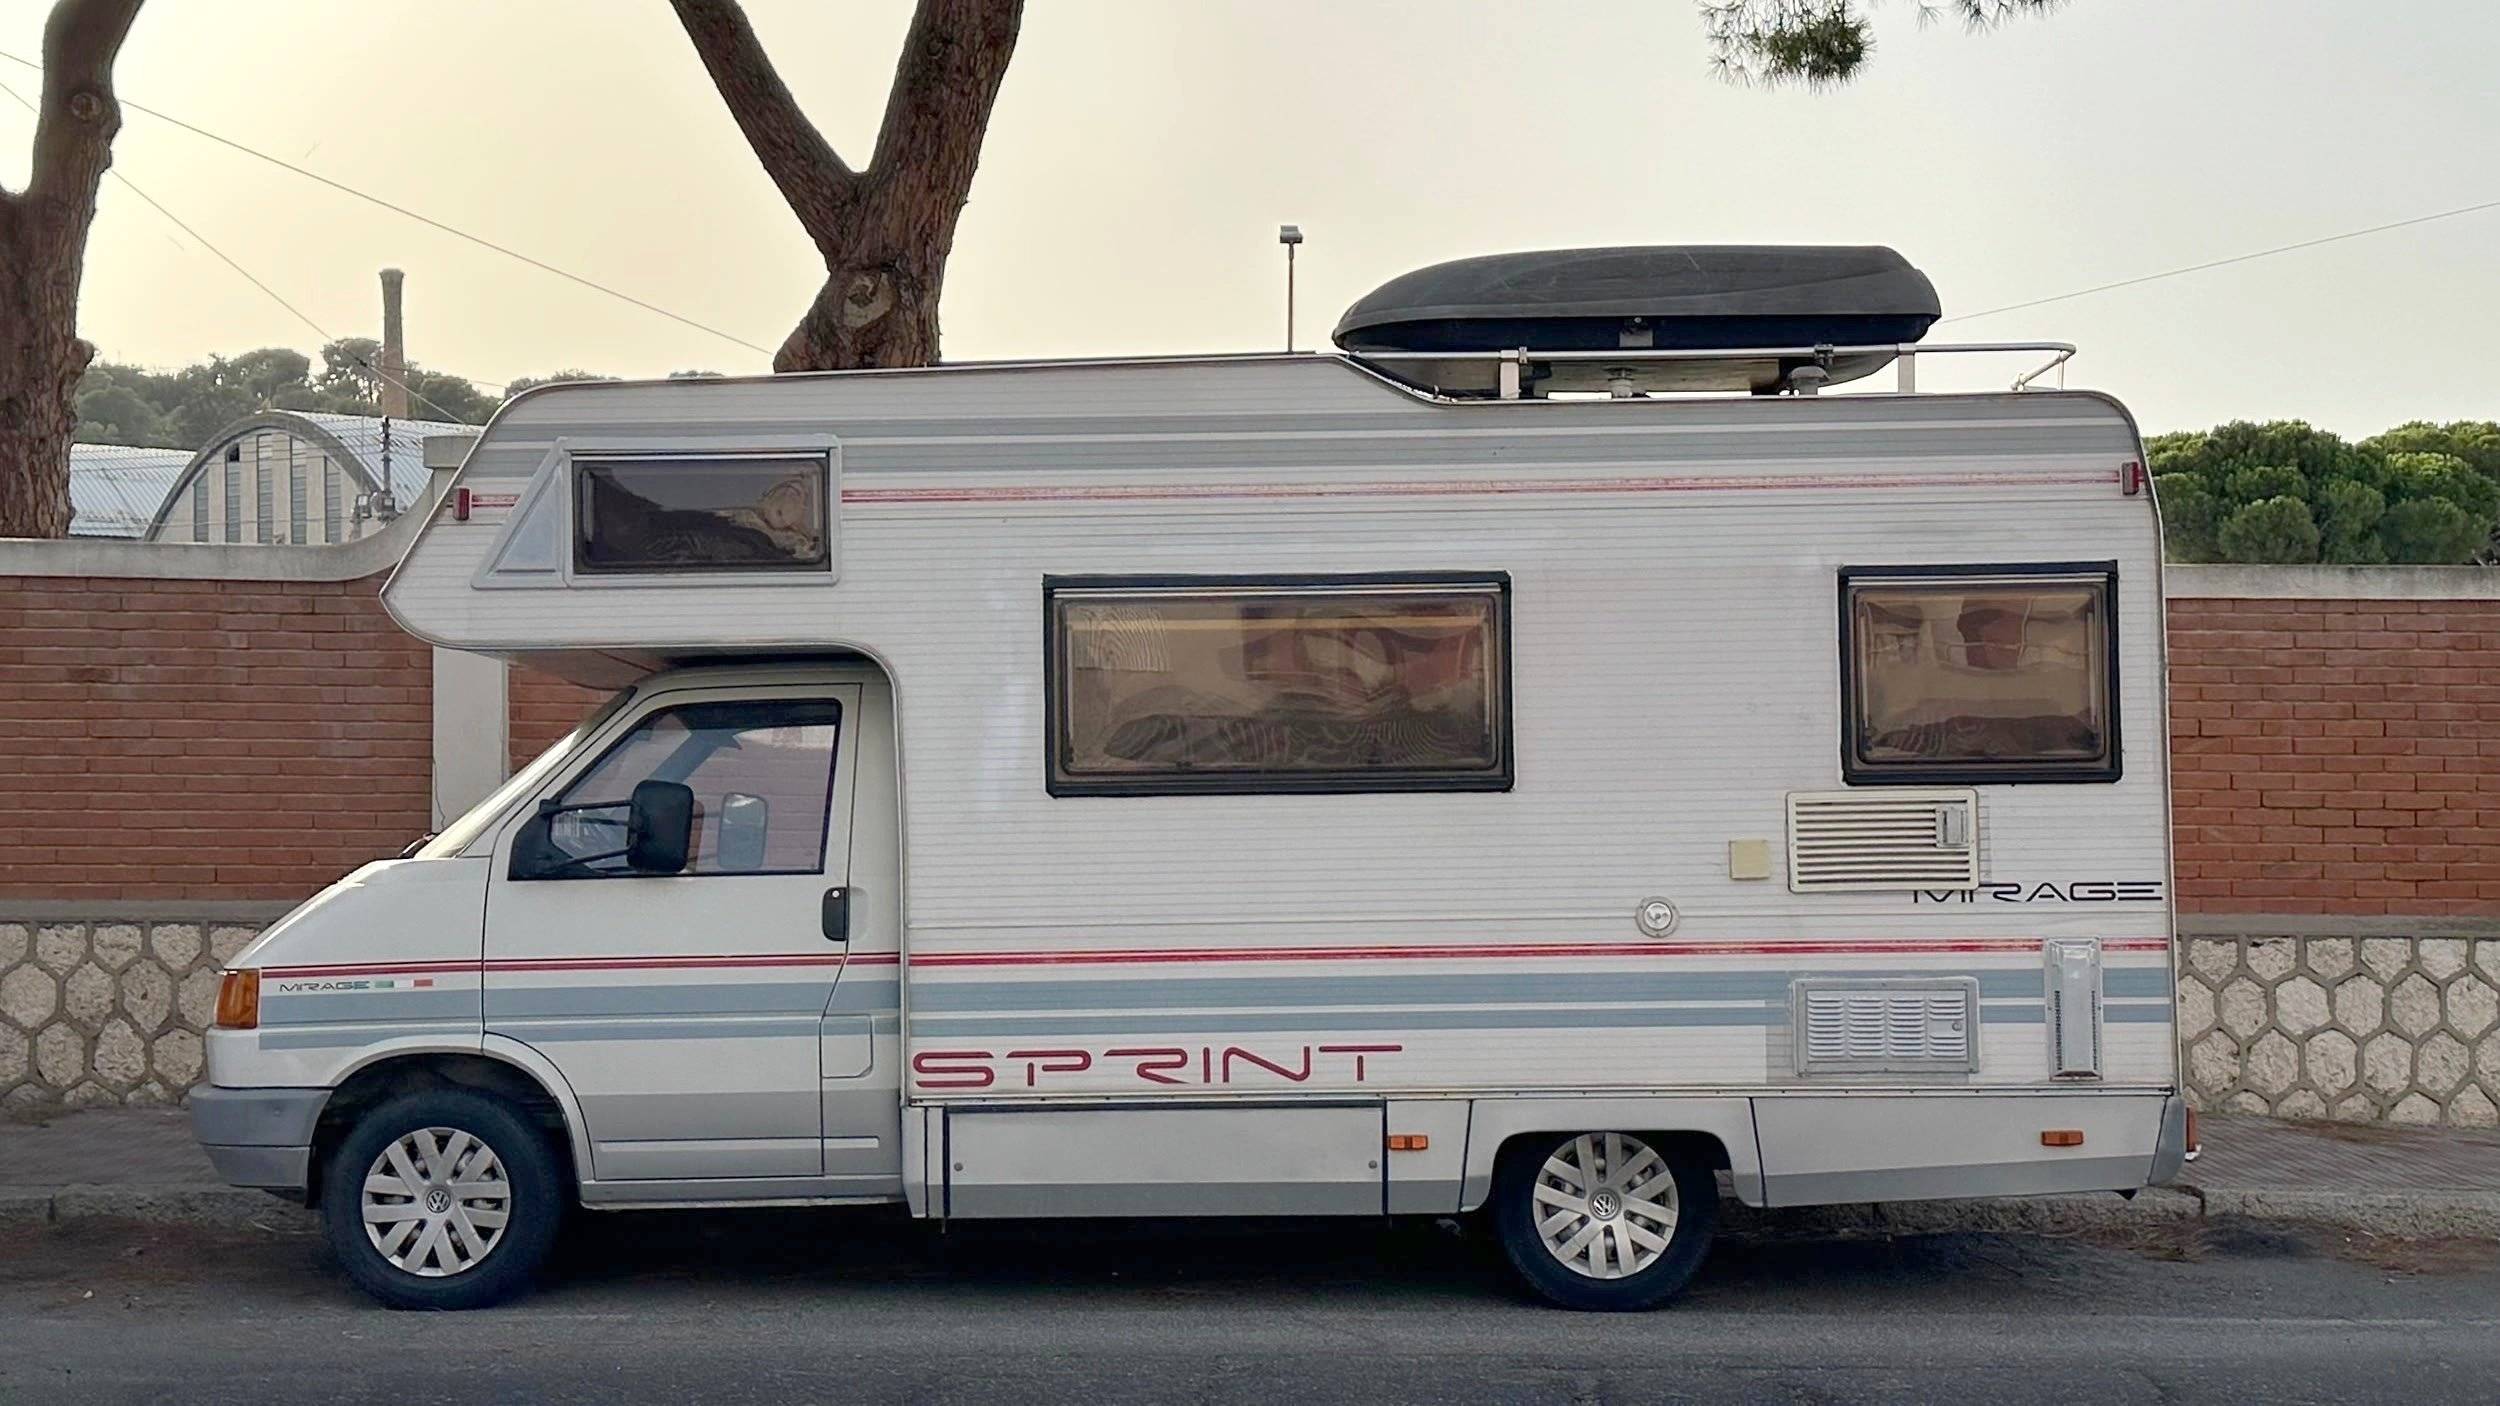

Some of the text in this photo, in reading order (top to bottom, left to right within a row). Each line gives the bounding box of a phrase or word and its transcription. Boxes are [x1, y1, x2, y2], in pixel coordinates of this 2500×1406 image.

[1913, 881, 2164, 904] MIRAGE
[279, 980, 370, 993] MIRAGE
[912, 1045, 1403, 1089] SPRINT
